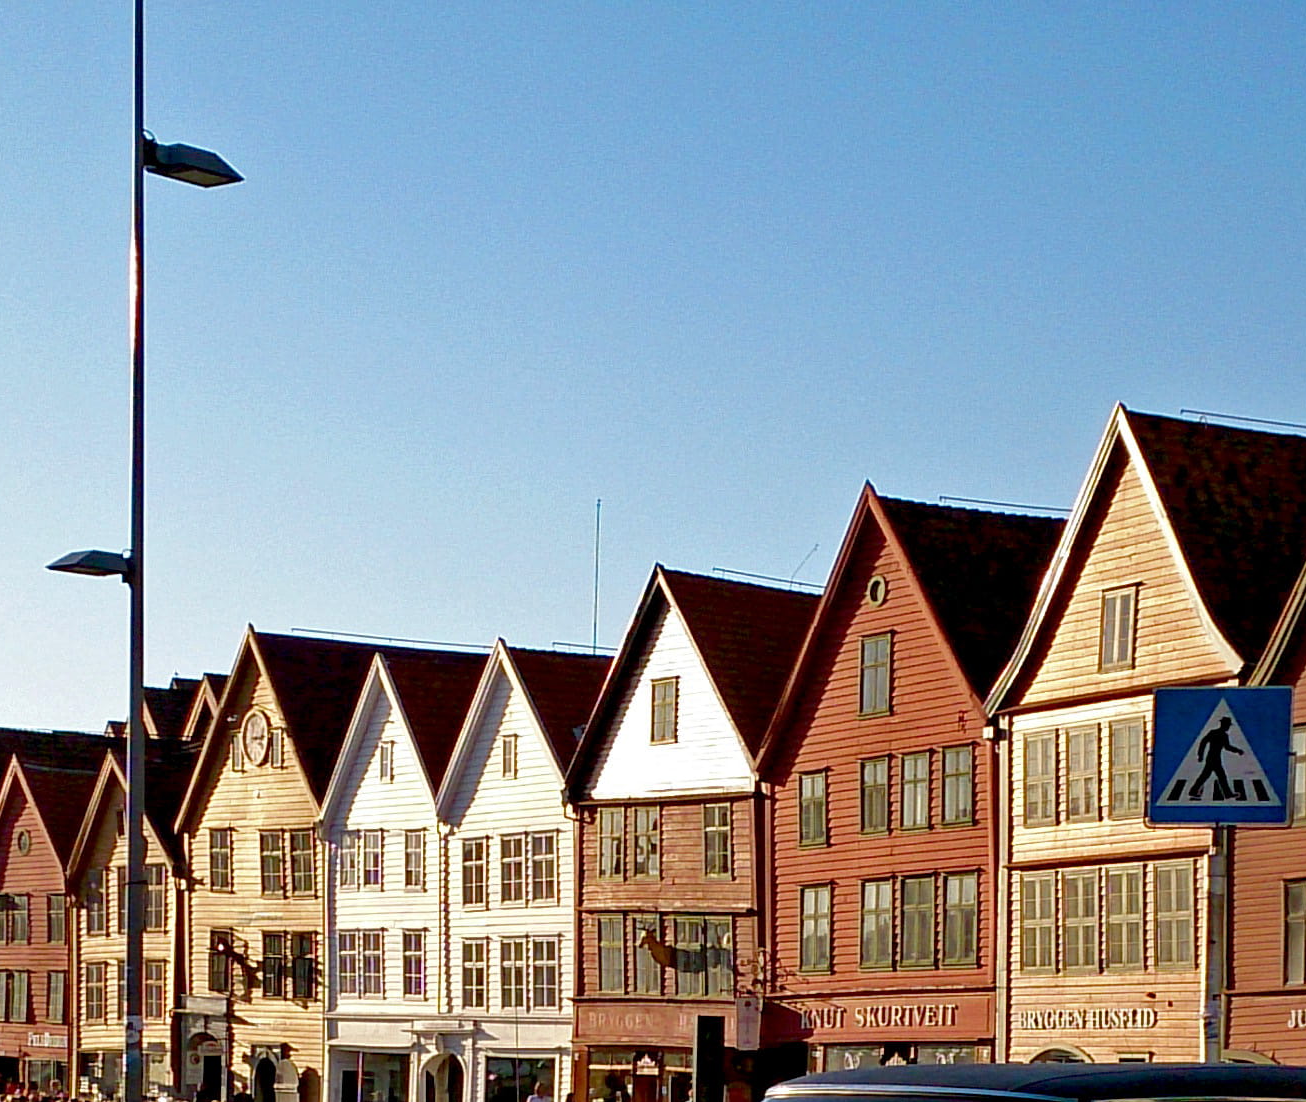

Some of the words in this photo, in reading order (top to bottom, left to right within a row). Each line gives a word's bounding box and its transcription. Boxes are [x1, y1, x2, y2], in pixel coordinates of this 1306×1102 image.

[588, 1011, 655, 1031] BRYGGEN
[800, 1007, 847, 1029] KNUT
[854, 1004, 959, 1028] SKURTVEIT
[1020, 1009, 1085, 1029] BRYGGEN
[1091, 1008, 1158, 1029] HUSFLID
